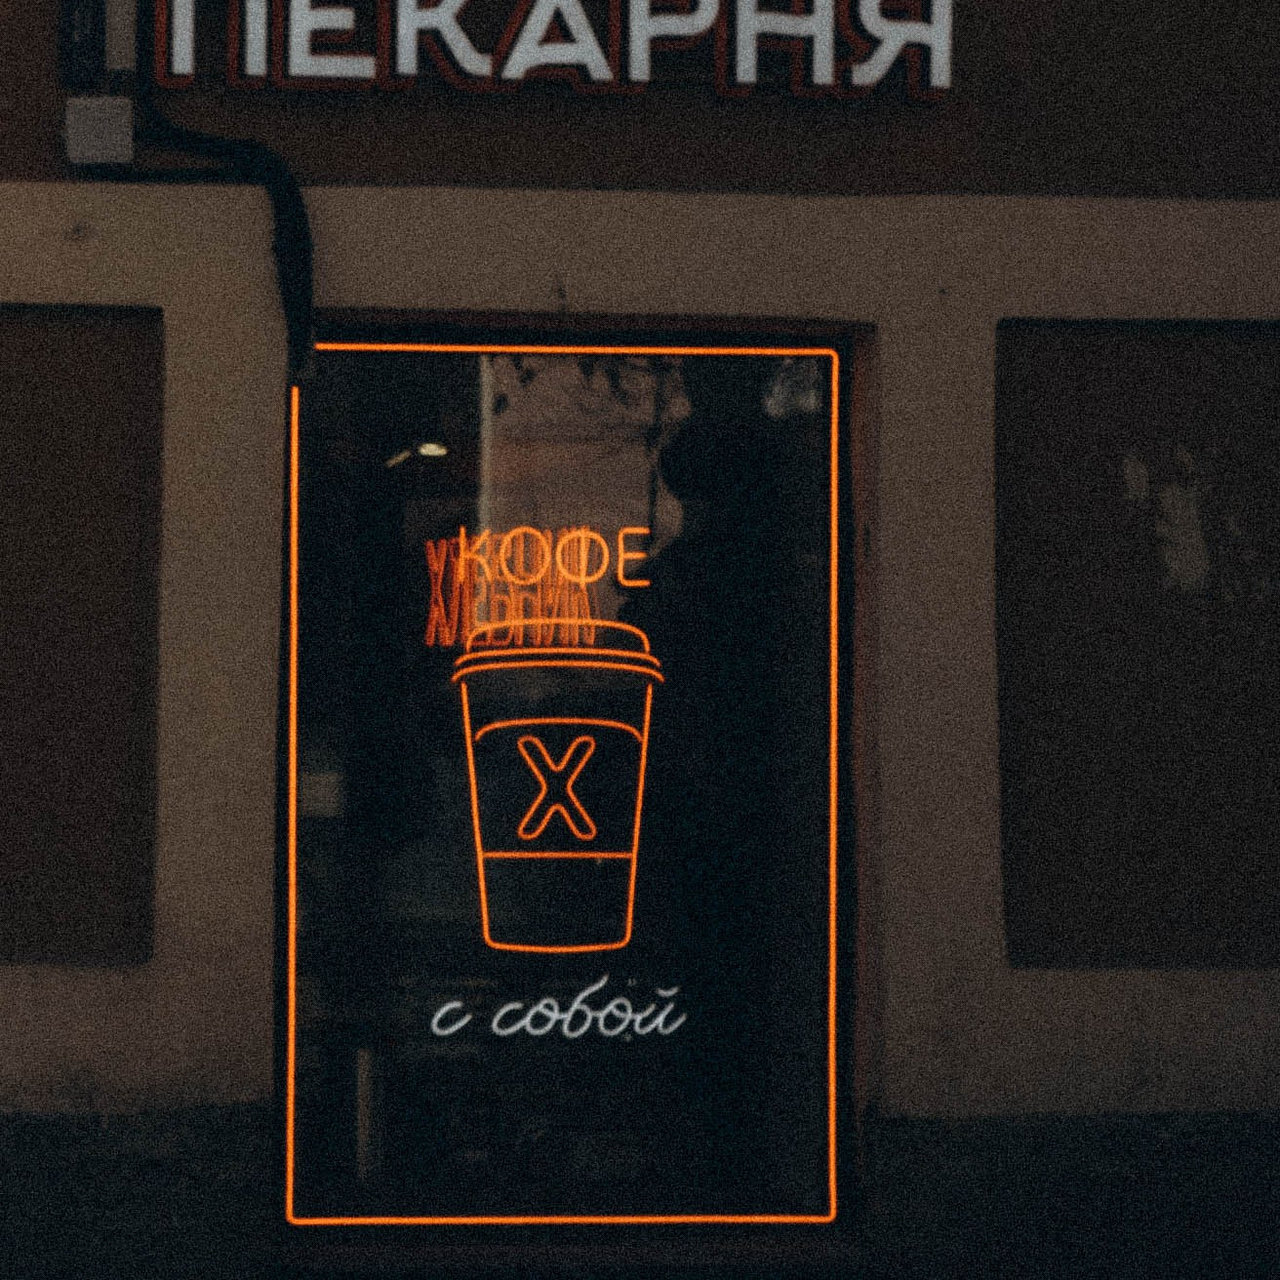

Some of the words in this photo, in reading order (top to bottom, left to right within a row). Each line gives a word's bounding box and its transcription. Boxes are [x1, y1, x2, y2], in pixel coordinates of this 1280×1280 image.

[458, 524, 652, 588] КОФЕ
[429, 998, 473, 1038] с
[489, 972, 689, 1040] собой
